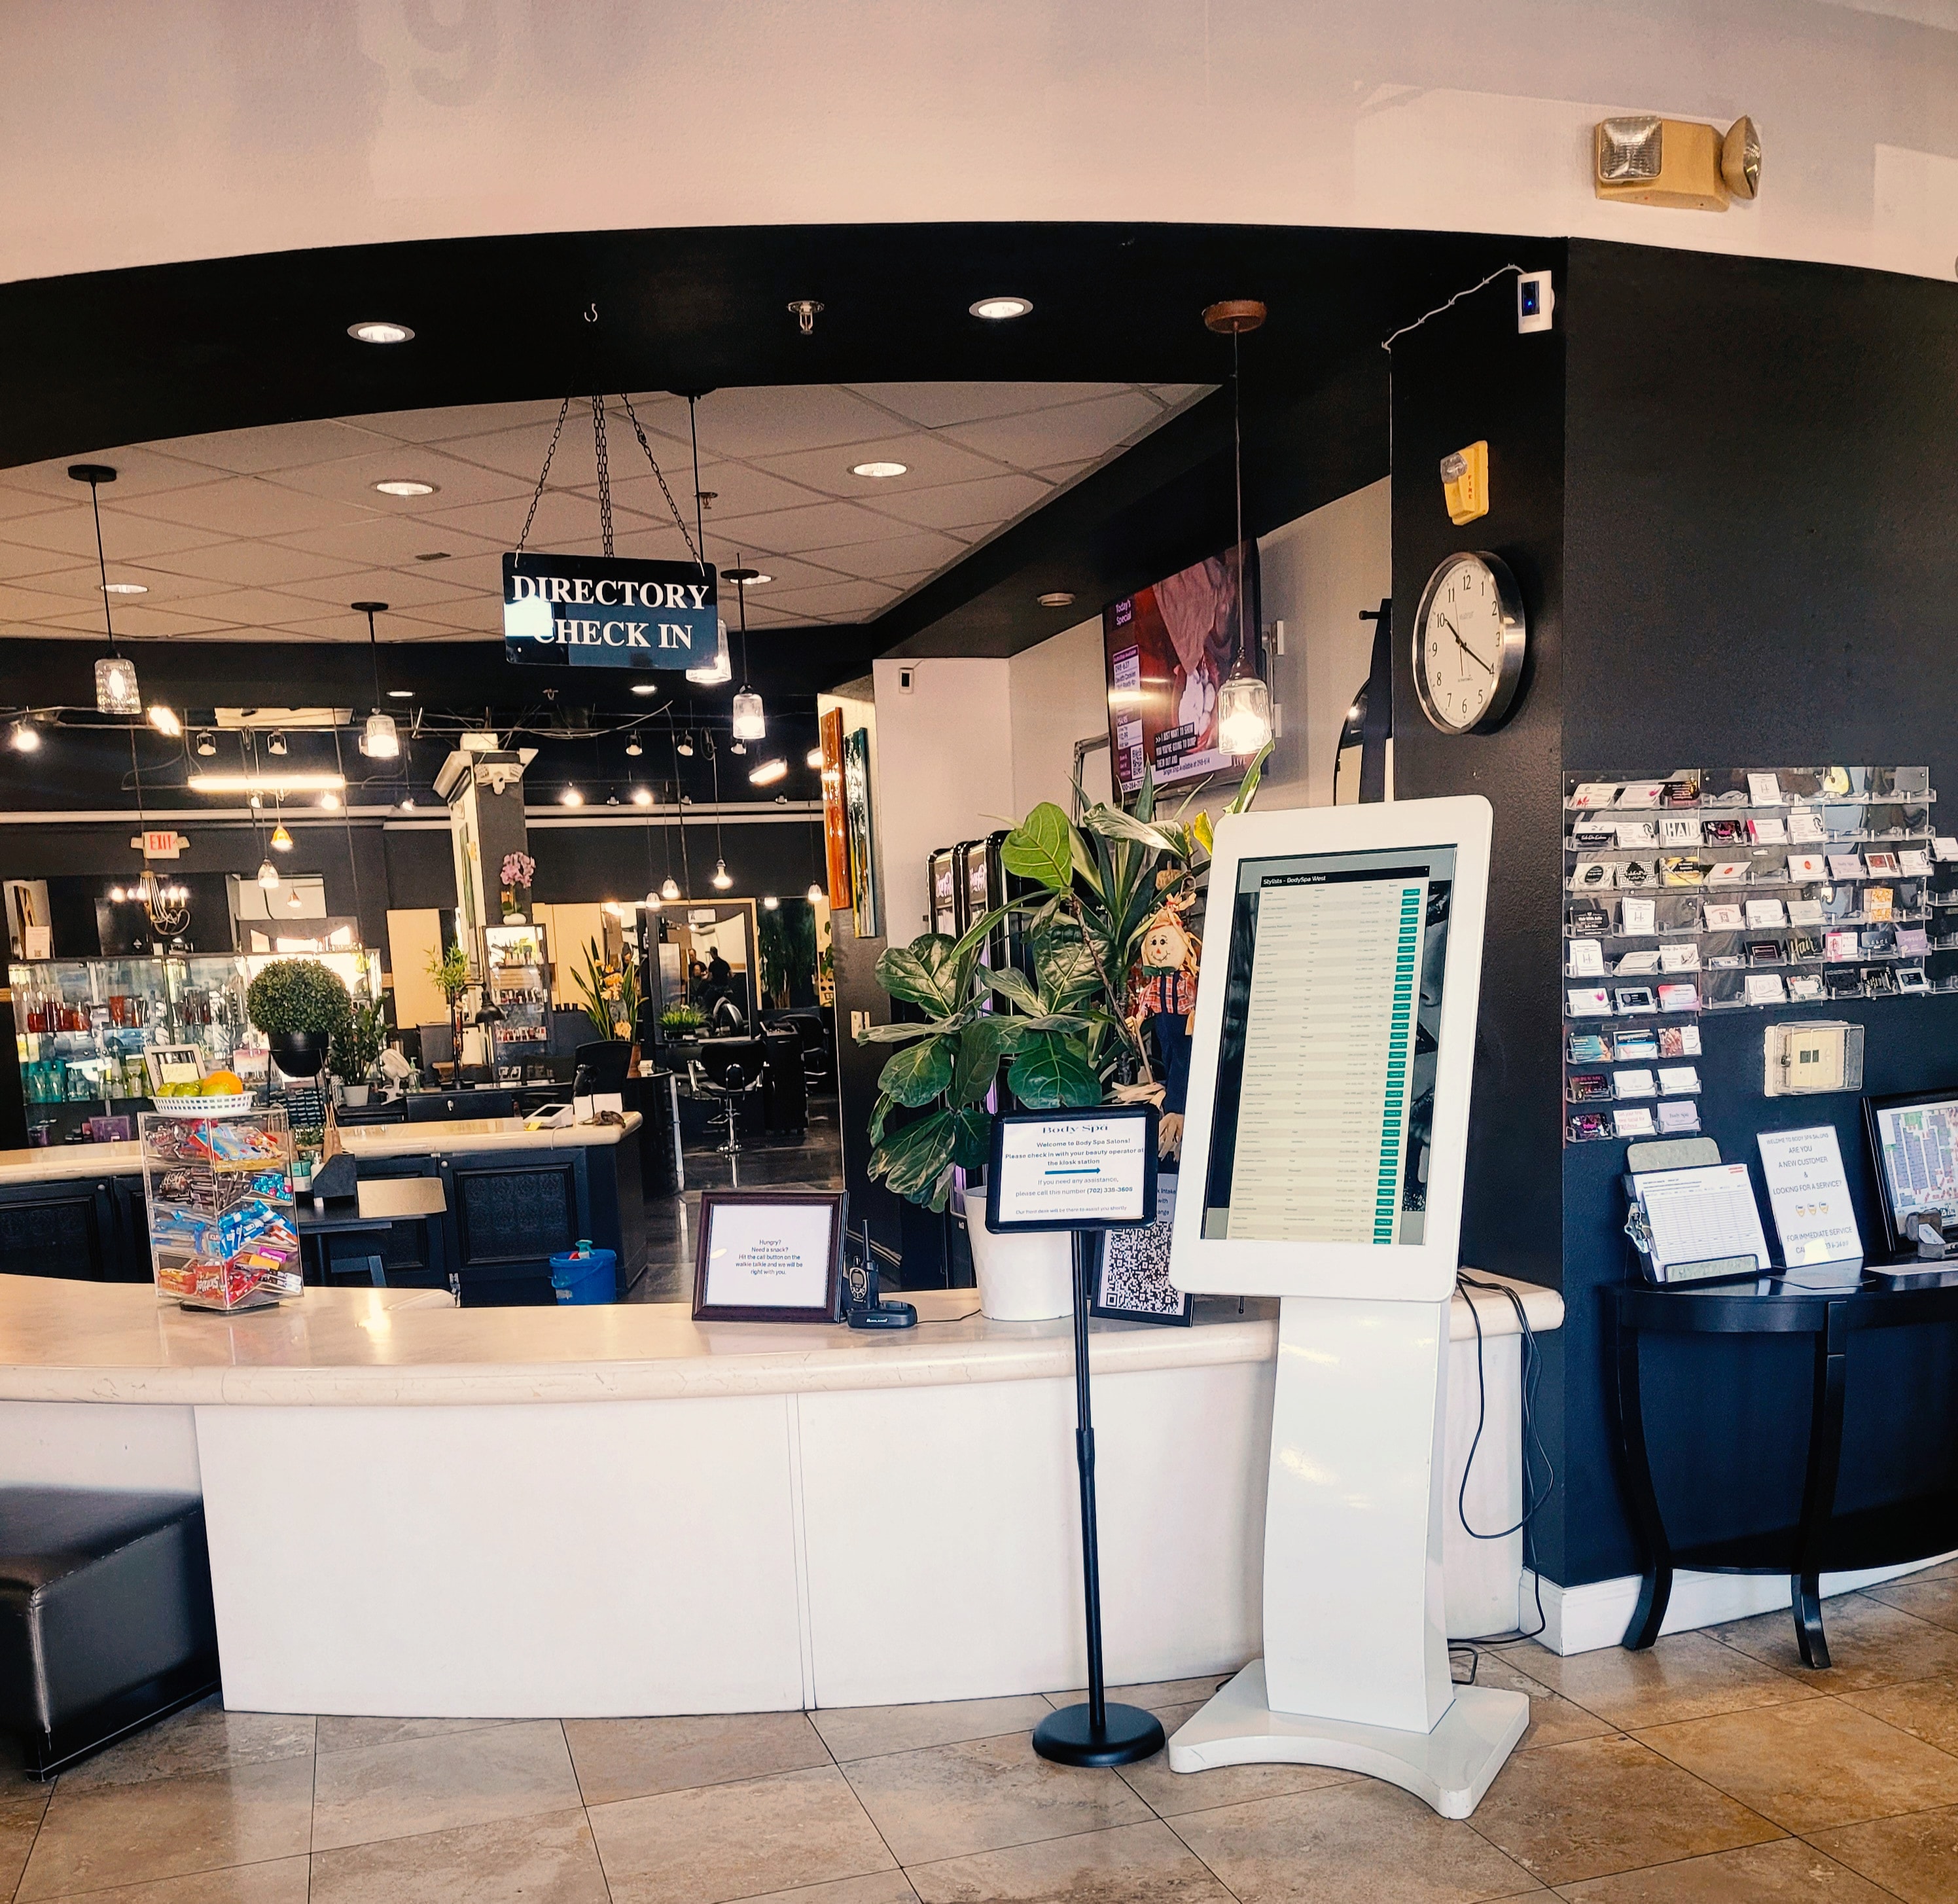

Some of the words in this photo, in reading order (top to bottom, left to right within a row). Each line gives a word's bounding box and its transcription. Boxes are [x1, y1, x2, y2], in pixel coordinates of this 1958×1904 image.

[1463, 575, 1471, 590] 12
[1481, 581, 1484, 596] 1
[511, 575, 709, 610] DIRECTORY
[1448, 587, 1455, 603] 11
[1491, 600, 1497, 617] 2
[1436, 613, 1445, 628] 10
[658, 623, 693, 650] IN
[1495, 631, 1501, 647] 3
[1432, 641, 1438, 657] 9
[1436, 672, 1442, 687] 8
[1447, 692, 1452, 707] 7
[1478, 689, 1483, 704] 5
[1462, 698, 1467, 714] 6
[150, 835, 171, 850] EXIT
[1797, 1156, 1828, 1166] CUSTOMER
[1773, 1185, 1798, 1195] LOOKING
[1800, 1183, 1811, 1192] FOR
[1816, 1180, 1842, 1189] SERVICE?
[1787, 1233, 1799, 1242] FOR
[1800, 1230, 1828, 1240] IMMEDIATE
[1829, 1227, 1853, 1236] SERVICE
